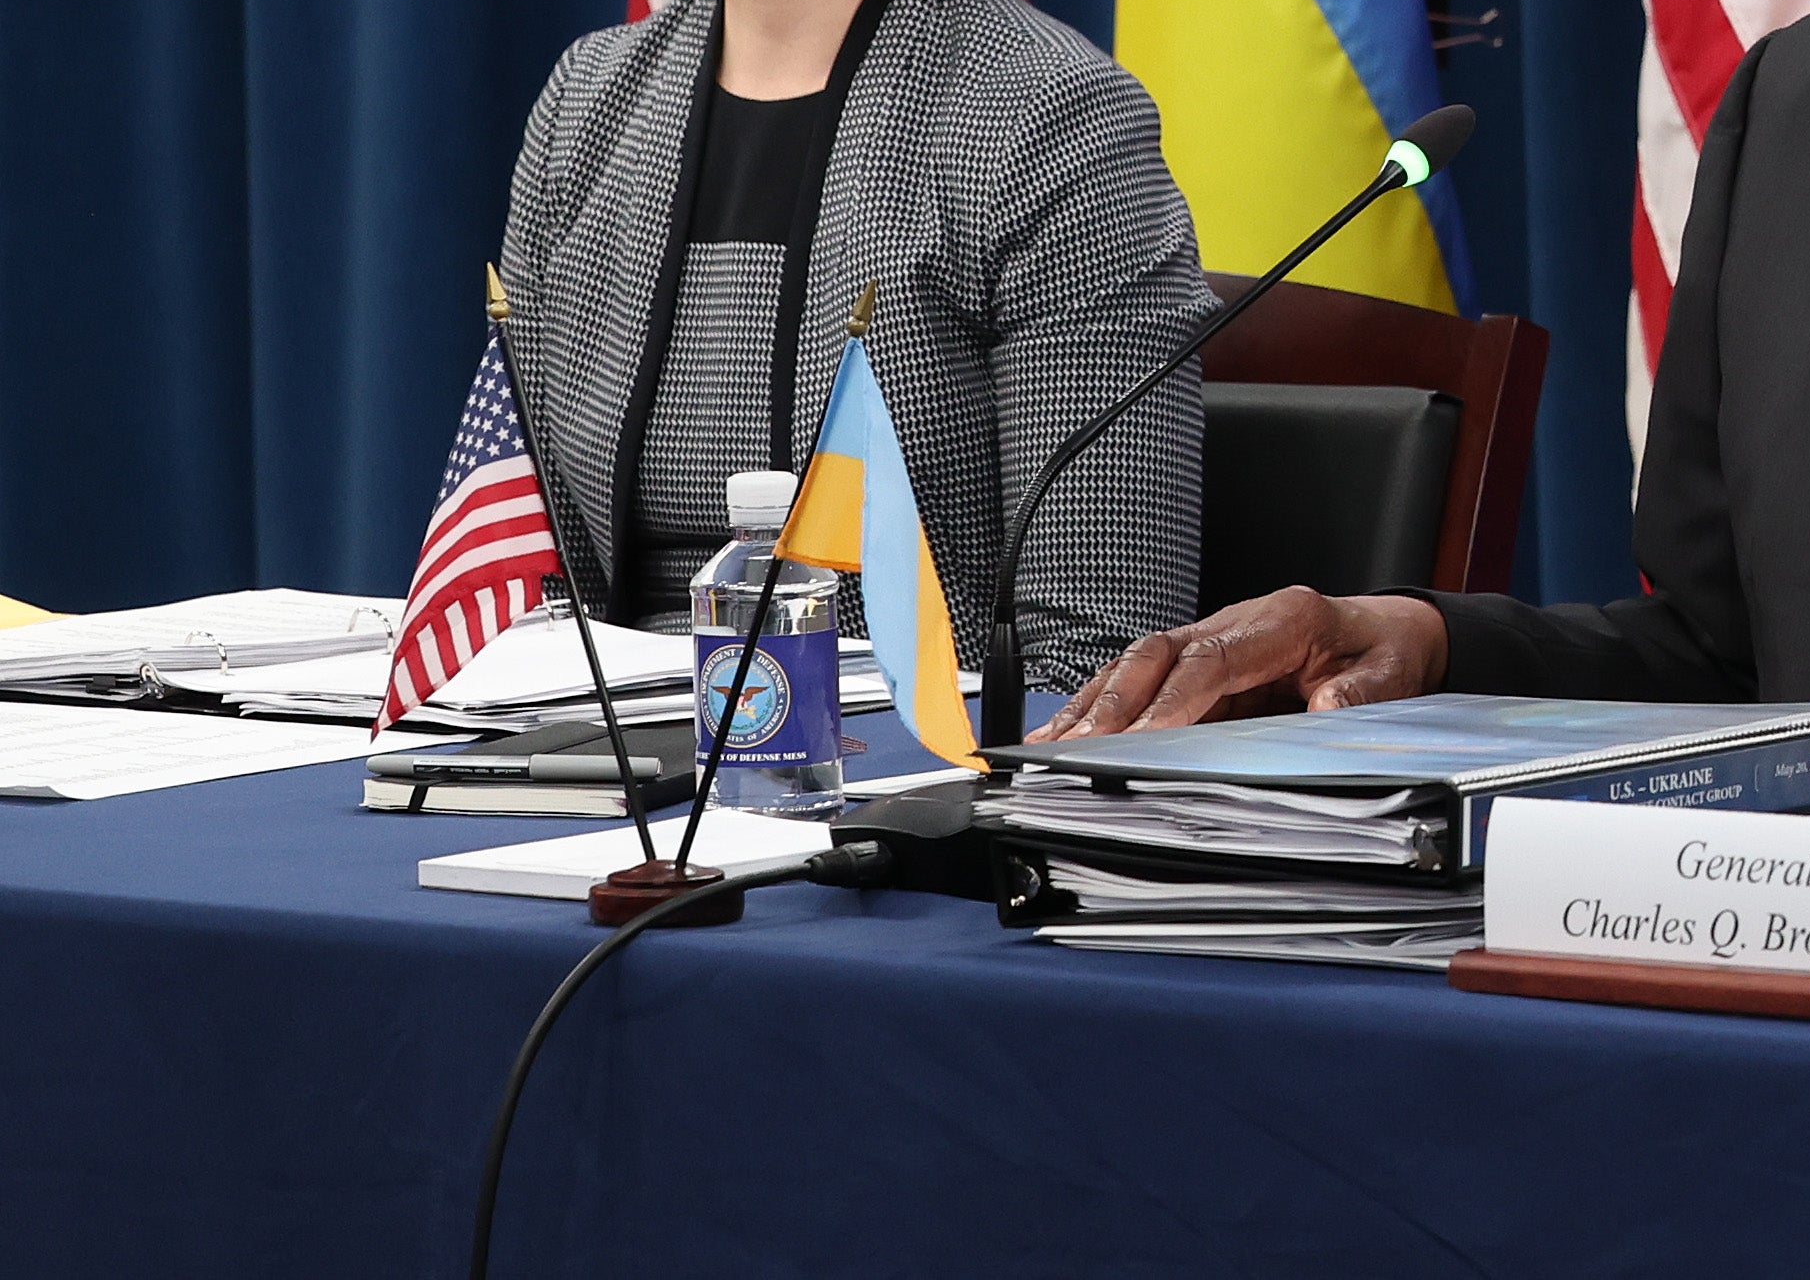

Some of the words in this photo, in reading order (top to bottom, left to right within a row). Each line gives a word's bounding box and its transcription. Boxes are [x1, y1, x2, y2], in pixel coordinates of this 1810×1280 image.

[726, 753, 738, 761] OF
[738, 753, 782, 762] DEFENSE
[783, 751, 807, 760] MESS
[1774, 763, 1795, 779] May
[1609, 781, 1635, 801] U.S.
[1649, 767, 1714, 794] UKRAINE
[1706, 785, 1743, 803] GROUP
[1562, 897, 1697, 946] Charles
[1710, 908, 1747, 959] Q.
